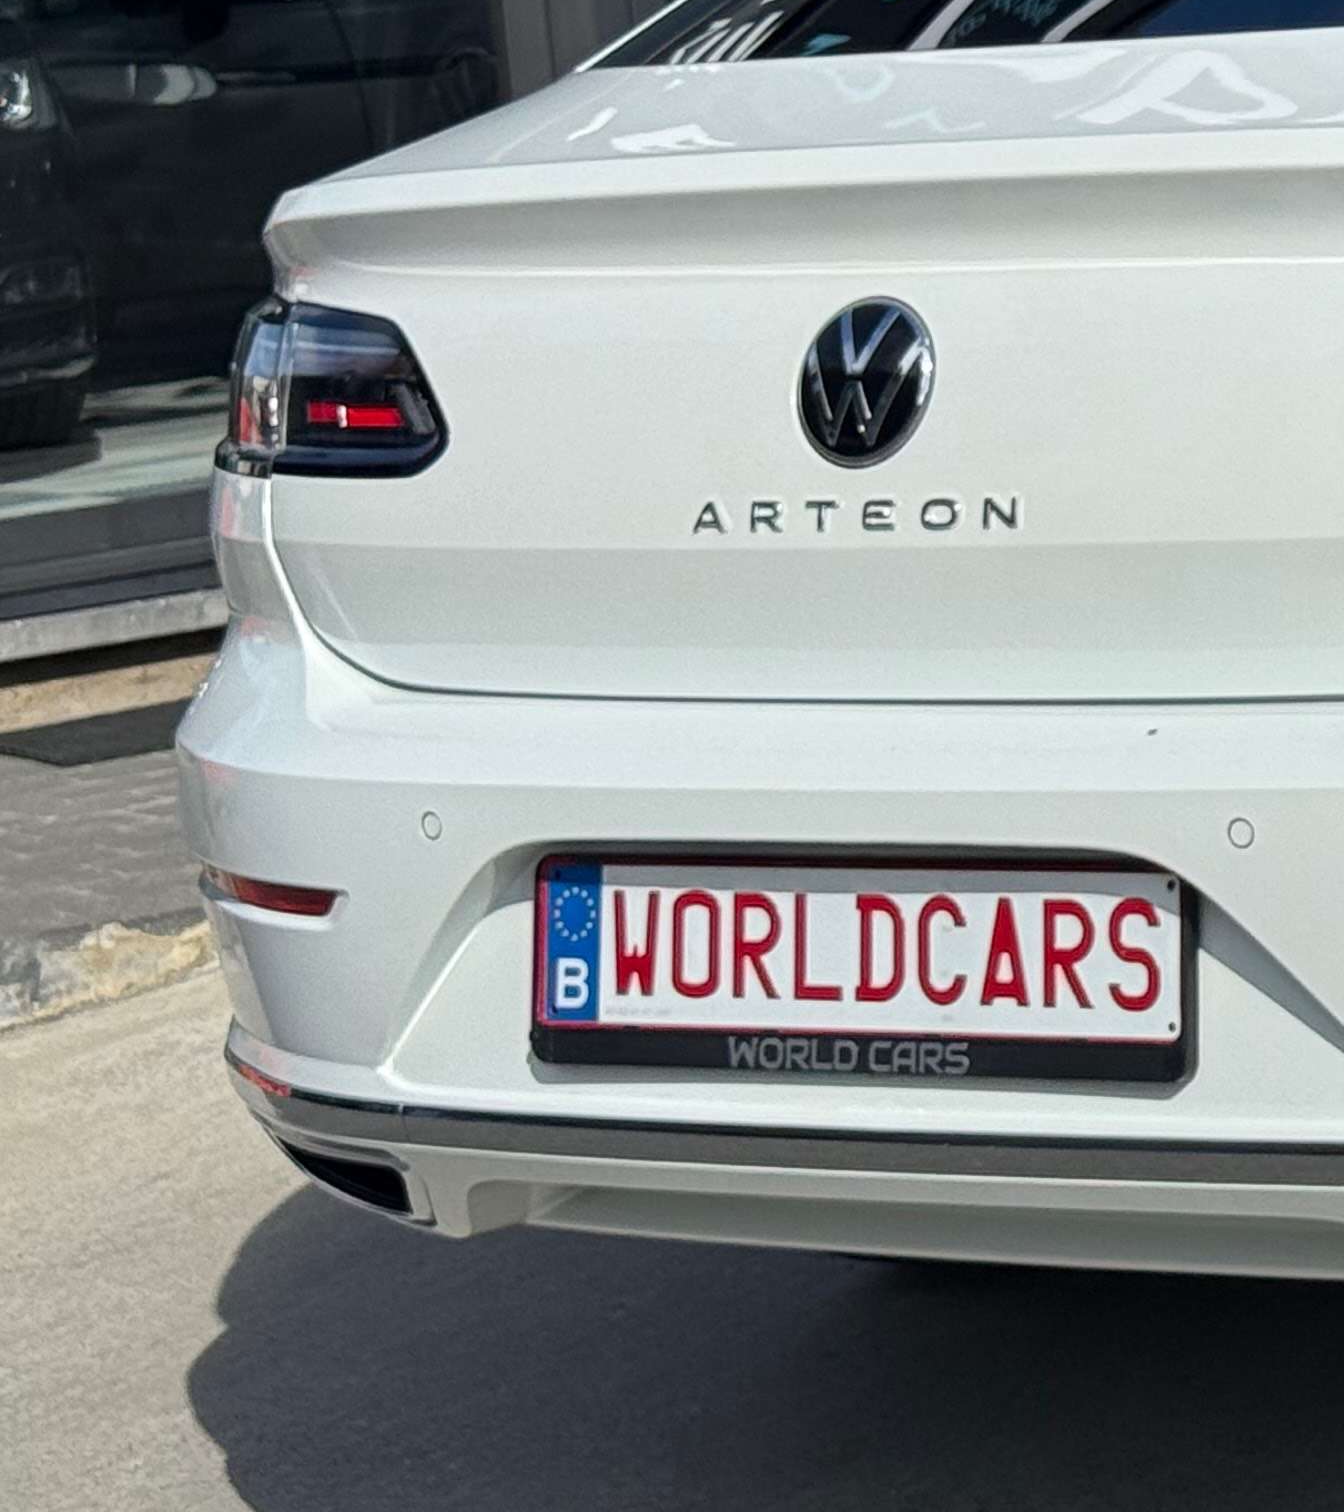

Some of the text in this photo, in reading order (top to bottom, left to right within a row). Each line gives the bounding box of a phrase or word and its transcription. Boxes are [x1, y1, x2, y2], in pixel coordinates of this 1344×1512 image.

[692, 495, 1020, 535] ARTEON
[613, 889, 1162, 1012] WORLDCARS
[555, 957, 590, 1010] B
[726, 1034, 972, 1075] WORLD CARS
